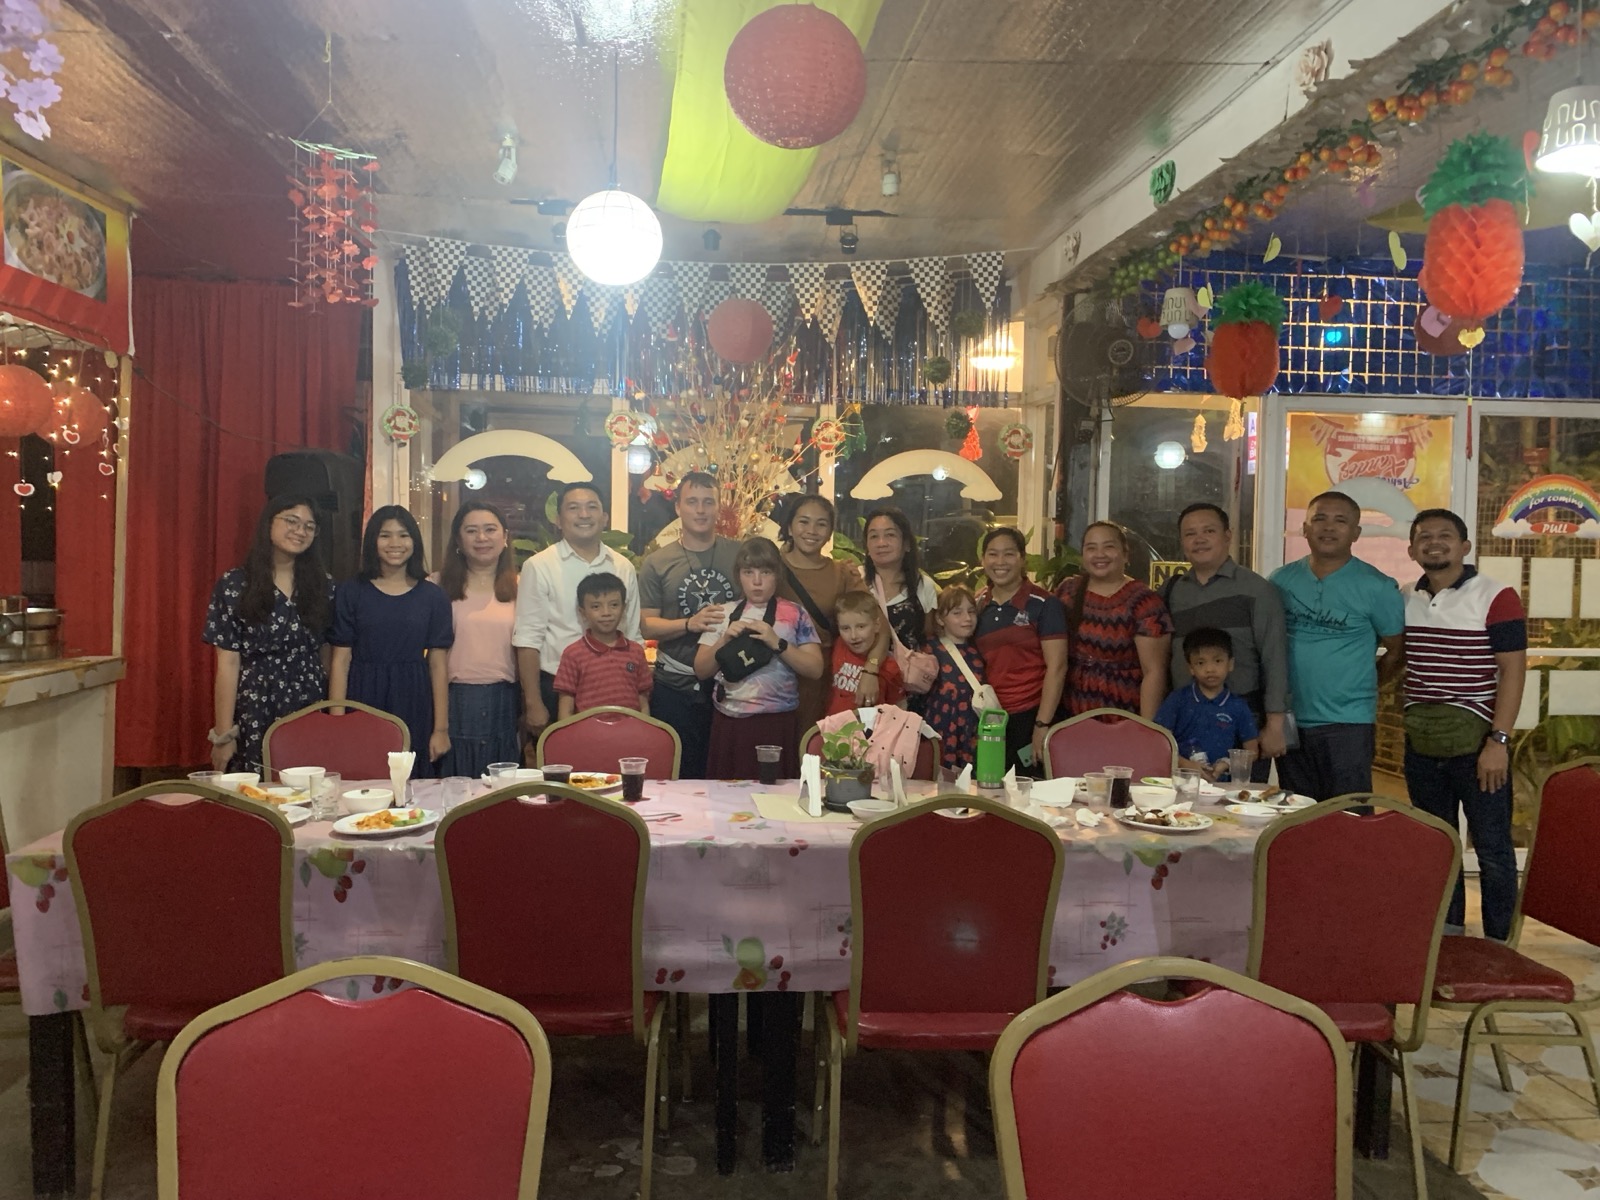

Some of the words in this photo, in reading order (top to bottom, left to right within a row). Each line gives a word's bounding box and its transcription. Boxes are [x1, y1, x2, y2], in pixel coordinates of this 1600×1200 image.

[1529, 497, 1545, 510] for
[1547, 495, 1584, 509] coming
[1542, 523, 1568, 534] PULL
[678, 573, 698, 616] DALLAS
[700, 568, 734, 599] COWBO
[737, 649, 756, 668] L
[832, 673, 861, 693] SOM
